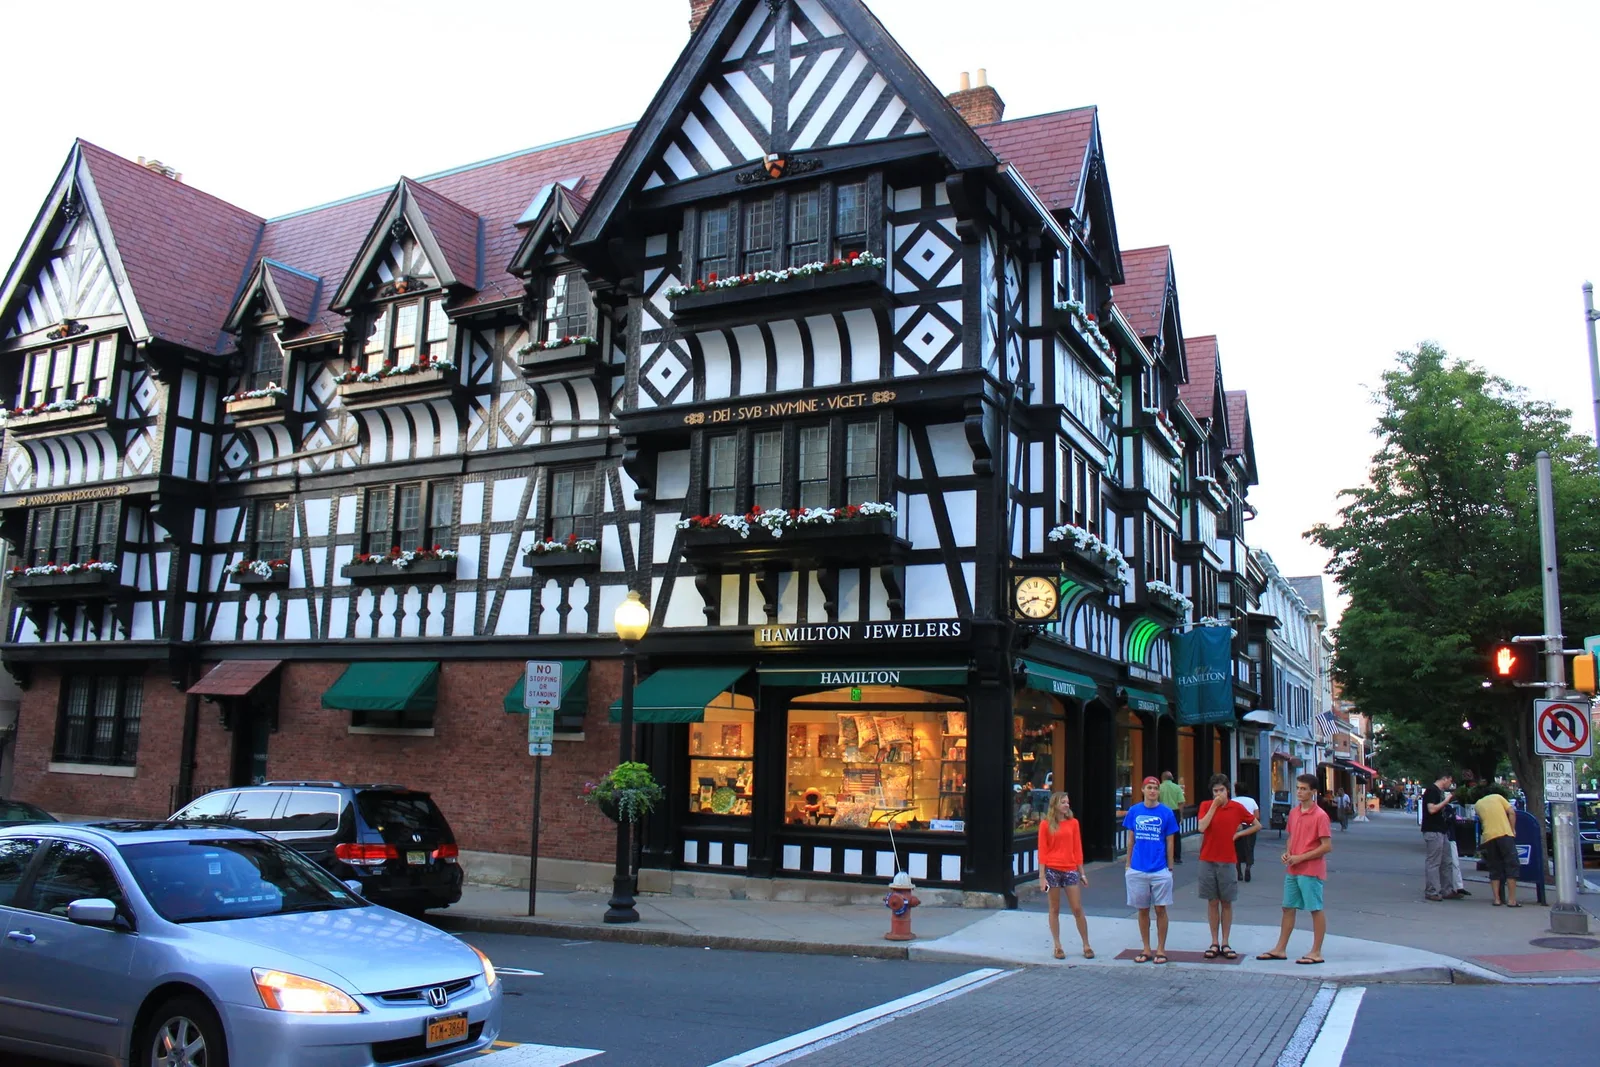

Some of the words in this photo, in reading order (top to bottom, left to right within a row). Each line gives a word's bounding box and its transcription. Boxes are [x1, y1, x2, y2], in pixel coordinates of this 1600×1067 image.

[712, 408, 731, 423] DEI
[738, 406, 762, 419] SVB
[769, 399, 819, 416] NVMINE
[827, 393, 866, 409] VIGET
[29, 495, 47, 506] ANNO
[760, 625, 851, 642] HAMILTON
[864, 622, 961, 639] JEWELERS
[536, 665, 552, 674] NO
[529, 675, 558, 683] STOPPING
[820, 671, 900, 684] HAMILTON
[1178, 671, 1226, 685] HAMILTON
[528, 690, 557, 698] STANDING
[1052, 680, 1076, 696] HAMILTON
[1552, 763, 1565, 772] NO
